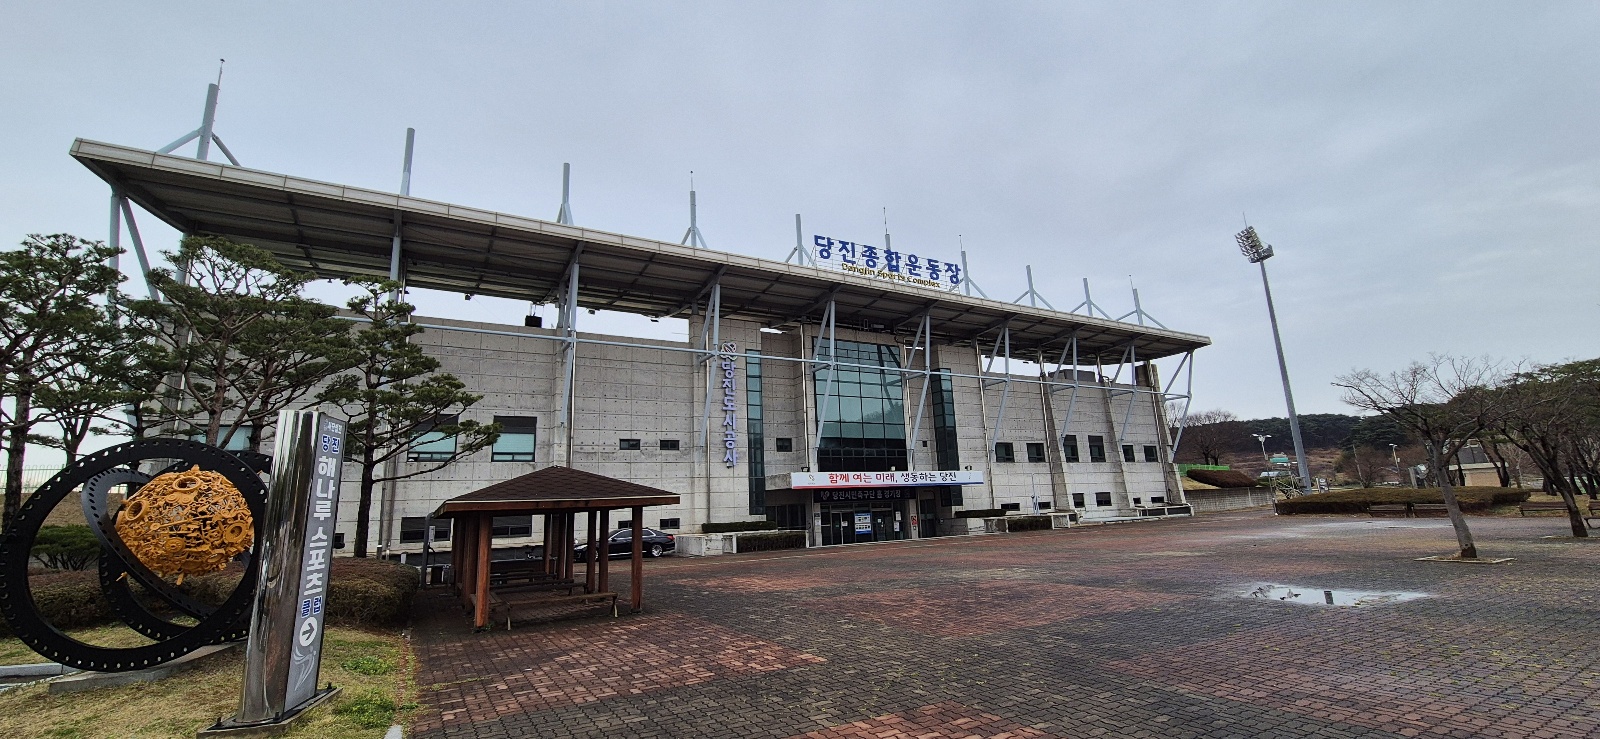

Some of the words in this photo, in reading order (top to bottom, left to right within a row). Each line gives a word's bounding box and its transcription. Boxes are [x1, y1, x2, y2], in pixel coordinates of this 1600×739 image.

[814, 235, 961, 284] 당진종합운동장
[841, 262, 875, 276] Dangjin
[877, 270, 906, 283] Sports
[907, 276, 941, 288] Complex
[721, 361, 738, 466] 당진도시공사
[322, 434, 340, 454] 당진
[828, 473, 850, 484] 함께
[852, 473, 873, 483] 여는
[875, 472, 898, 484] 미래,
[900, 472, 937, 483] 생동하는
[939, 472, 957, 482] 당진
[301, 596, 322, 618] 클럽
